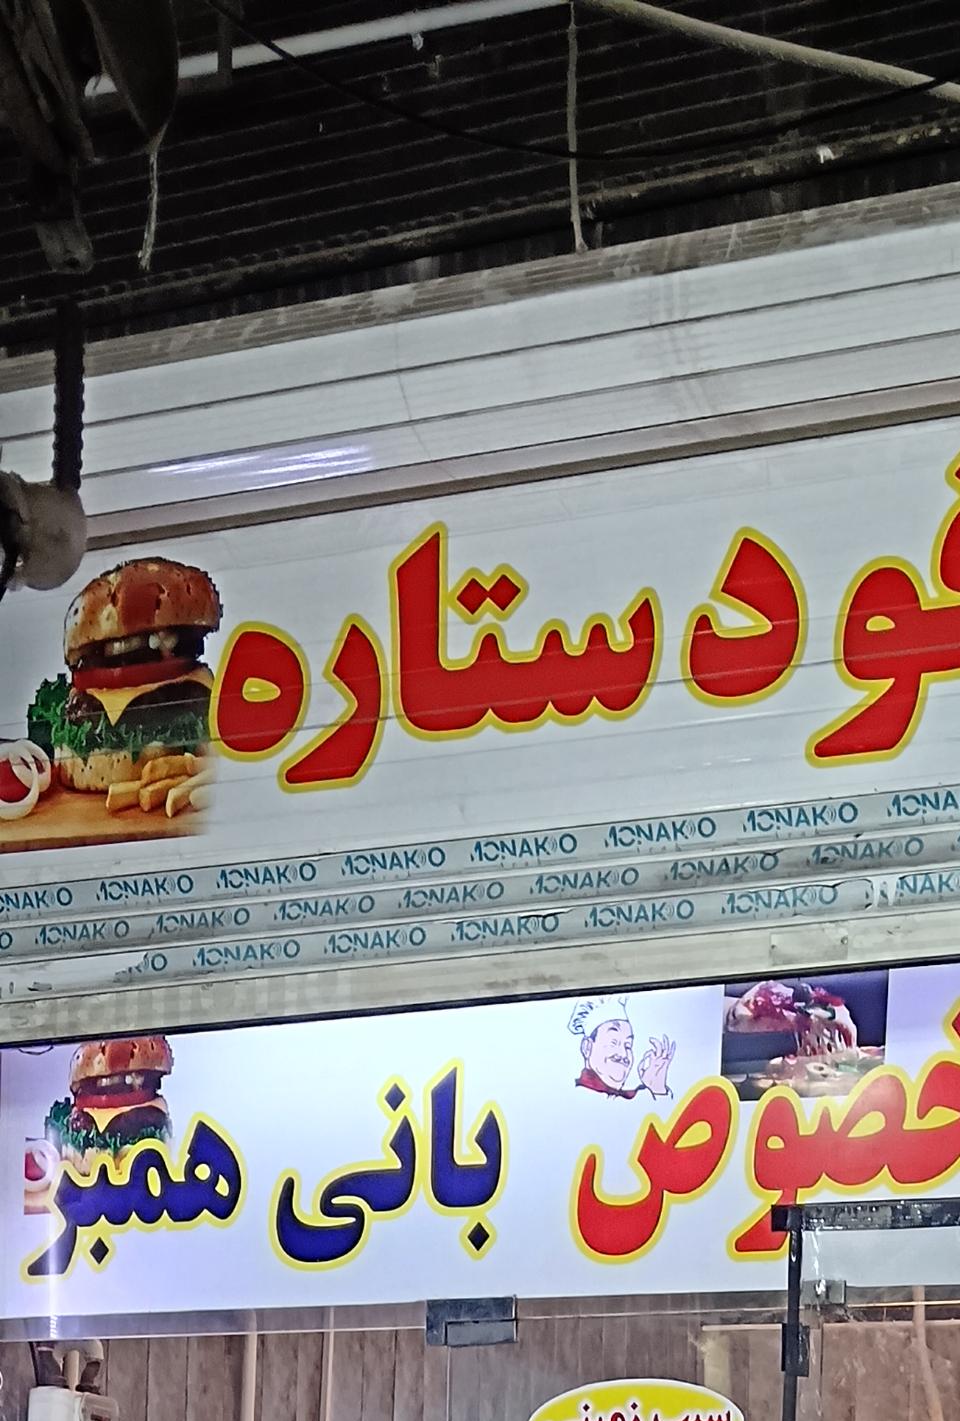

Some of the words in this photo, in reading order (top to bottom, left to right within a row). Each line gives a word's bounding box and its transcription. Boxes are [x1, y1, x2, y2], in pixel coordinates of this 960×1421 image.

[212, 523, 661, 792] ستاره
[20, 1114, 245, 1282] همبر
[272, 1060, 506, 1271] بانی
